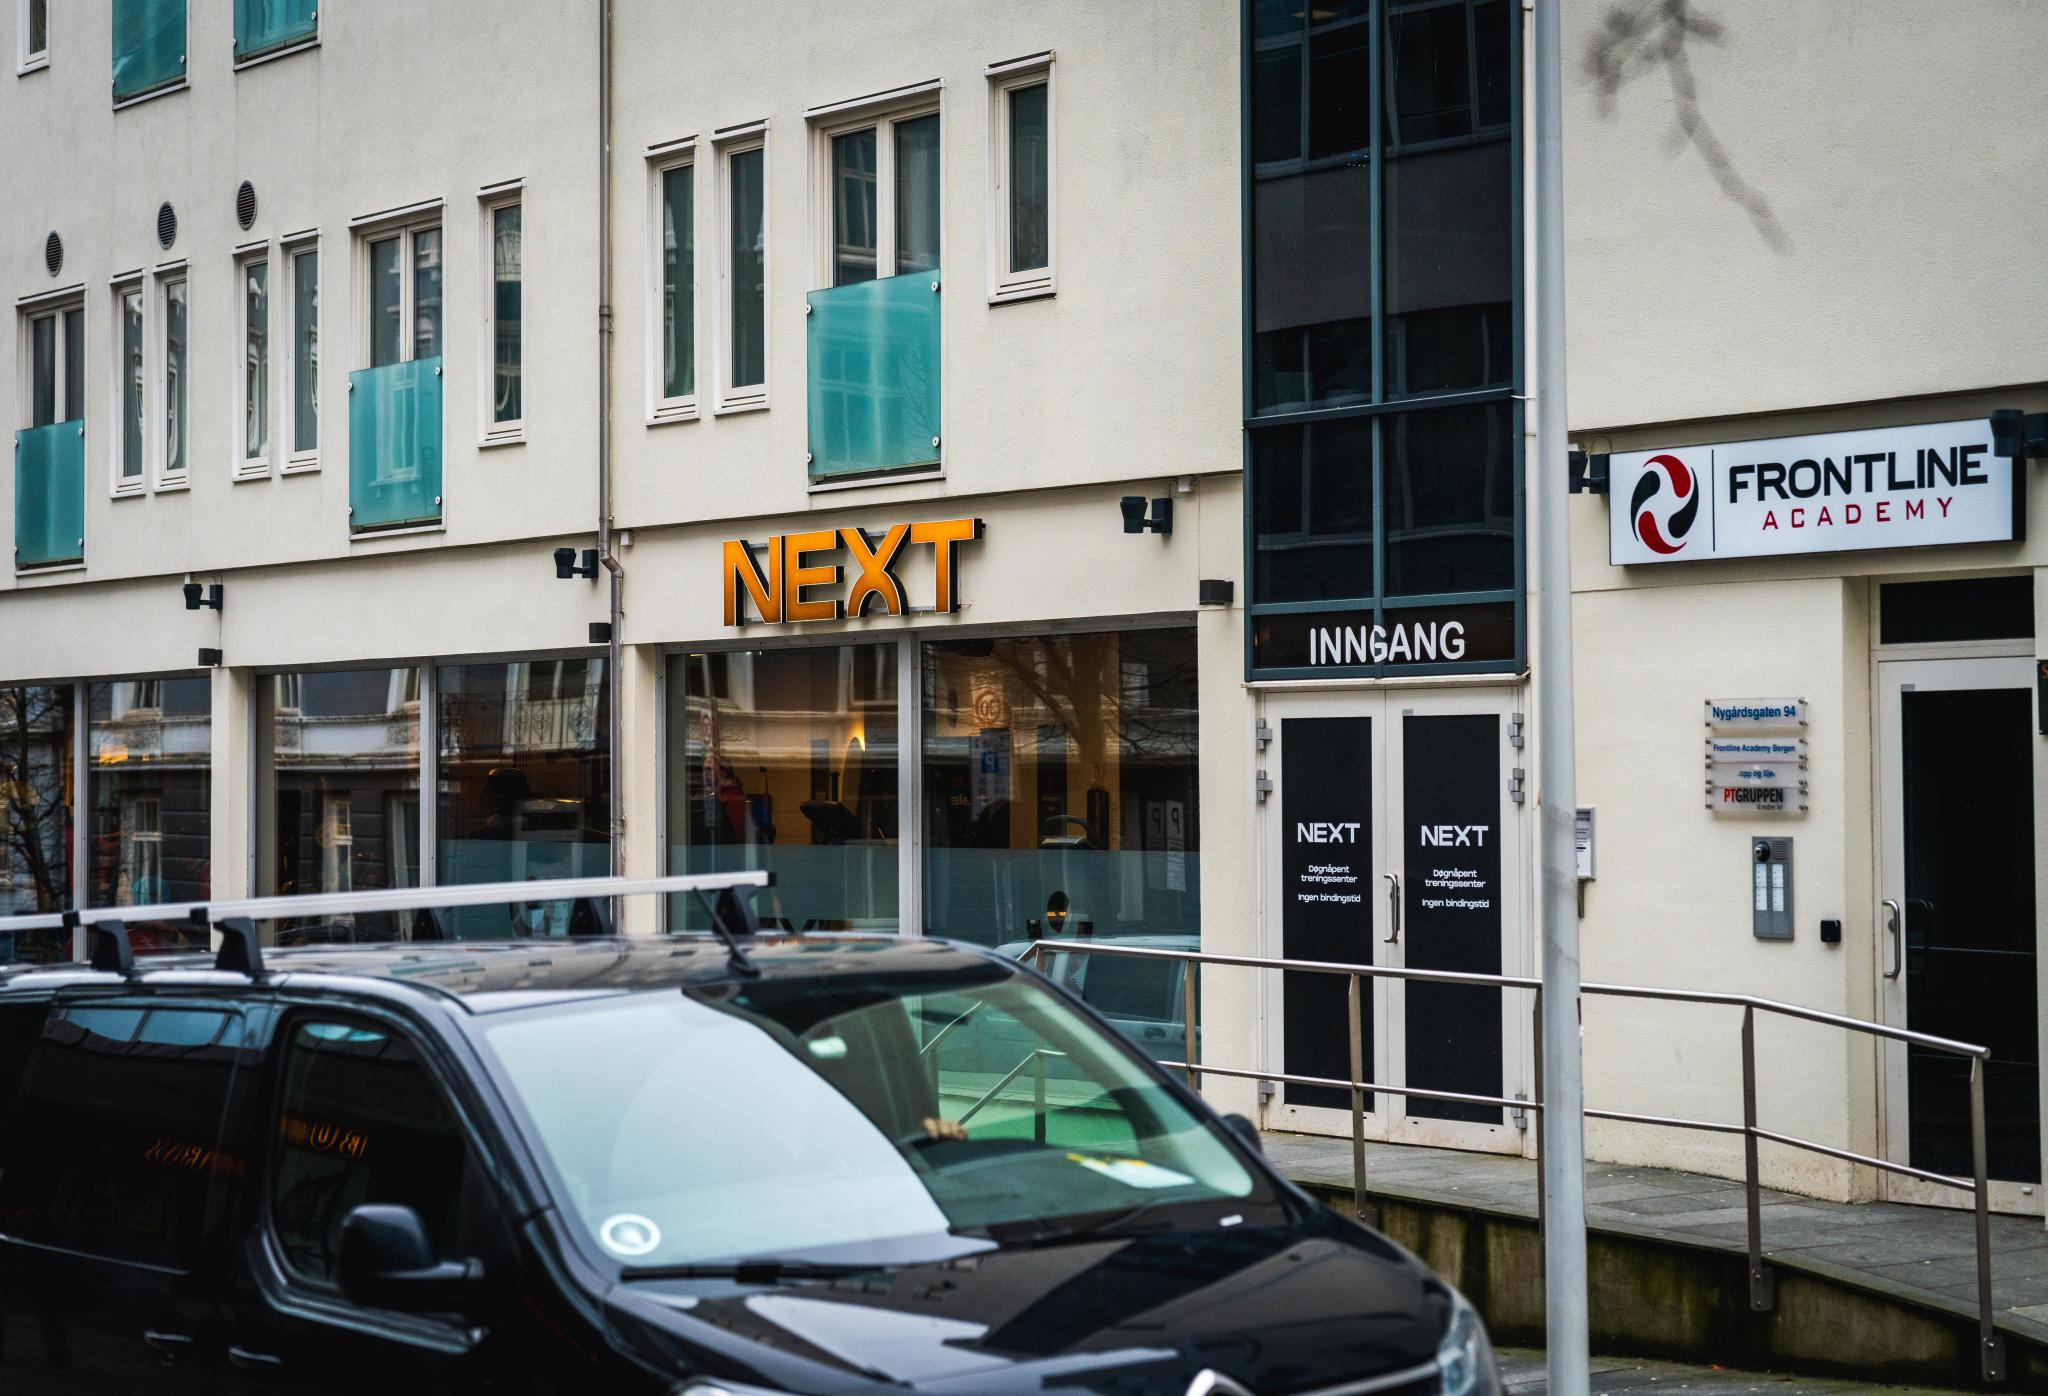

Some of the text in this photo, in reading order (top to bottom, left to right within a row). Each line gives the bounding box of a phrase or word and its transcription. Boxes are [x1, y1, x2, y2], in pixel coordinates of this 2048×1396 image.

[1729, 443, 1988, 504] FRONTLINE
[1762, 496, 1954, 531] ACADEMY
[723, 517, 983, 627] NEXT
[1310, 620, 1465, 665] INNGANG
[1712, 705, 1797, 720] Nygårdsgaten 94
[1713, 744, 1796, 754] Frontline Academy Bergen
[1724, 788, 1784, 803] PTGRUPPEN
[1297, 822, 1361, 843] NEXT
[1421, 825, 1489, 847] NEXT
[1308, 863, 1350, 875] Døgnåpent
[1433, 867, 1478, 879] Døgnåpent
[1300, 874, 1358, 884] treningssenter
[1425, 879, 1487, 889] treningssenter
[1298, 893, 1361, 904] Ingen bindingstid
[1422, 898, 1490, 910] Ingen bindingstid
